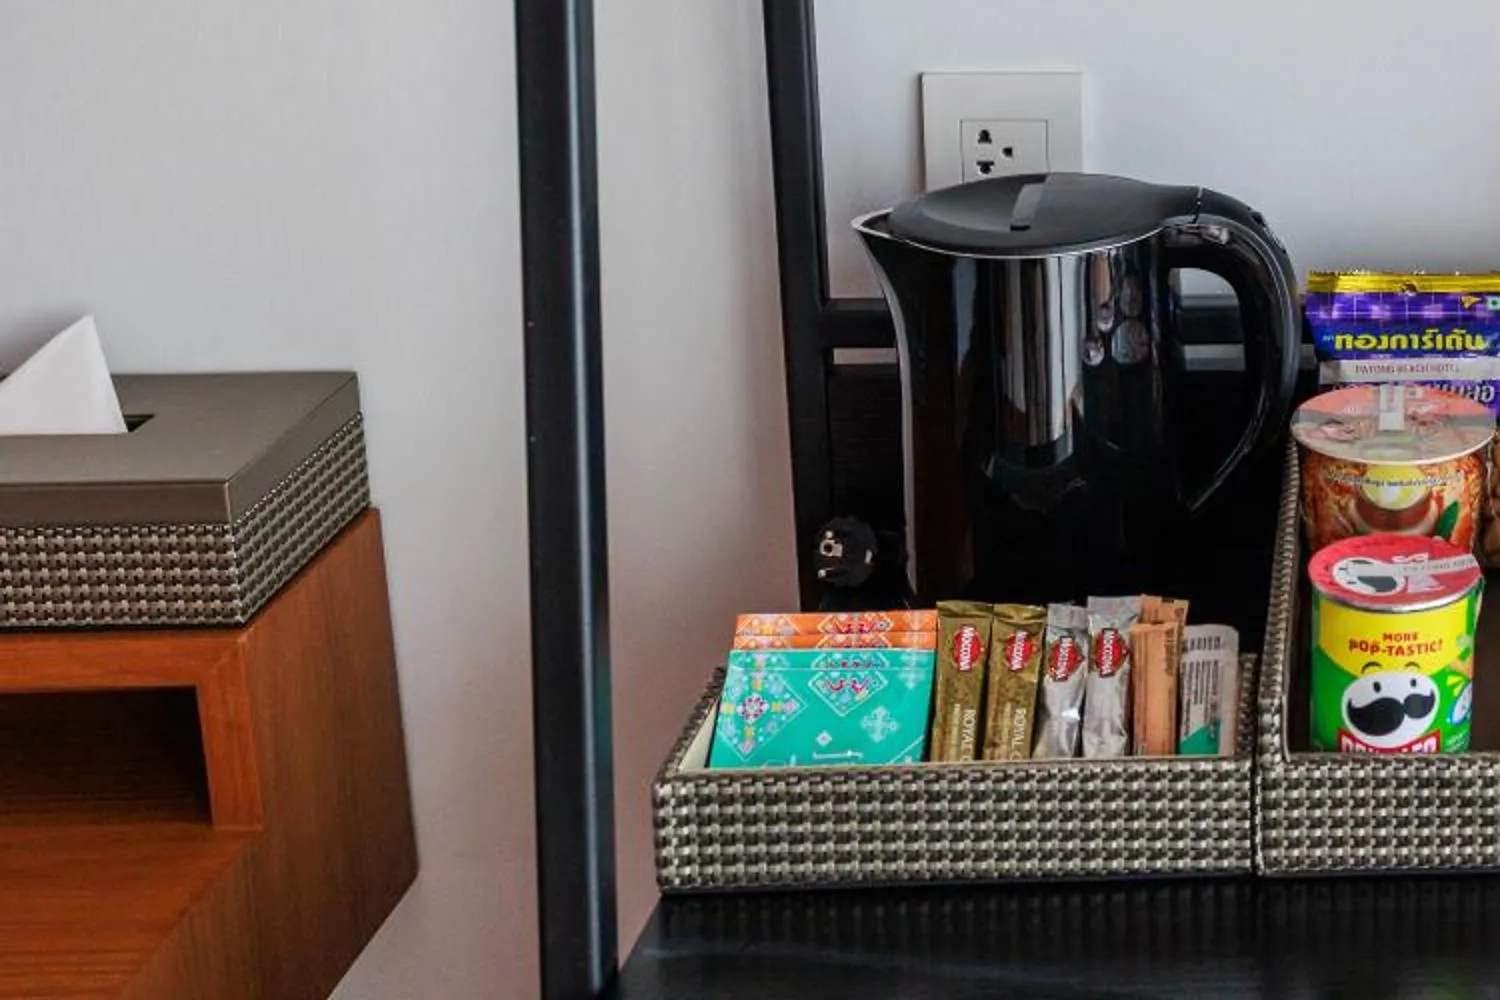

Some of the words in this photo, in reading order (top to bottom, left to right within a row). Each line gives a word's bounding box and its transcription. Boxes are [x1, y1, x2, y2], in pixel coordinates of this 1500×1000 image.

[1348, 638, 1443, 657] POP-TASTIC!
[1382, 631, 1419, 642] MORE
[960, 708, 977, 751] ROYAL
[1011, 707, 1027, 748] ROYAL
